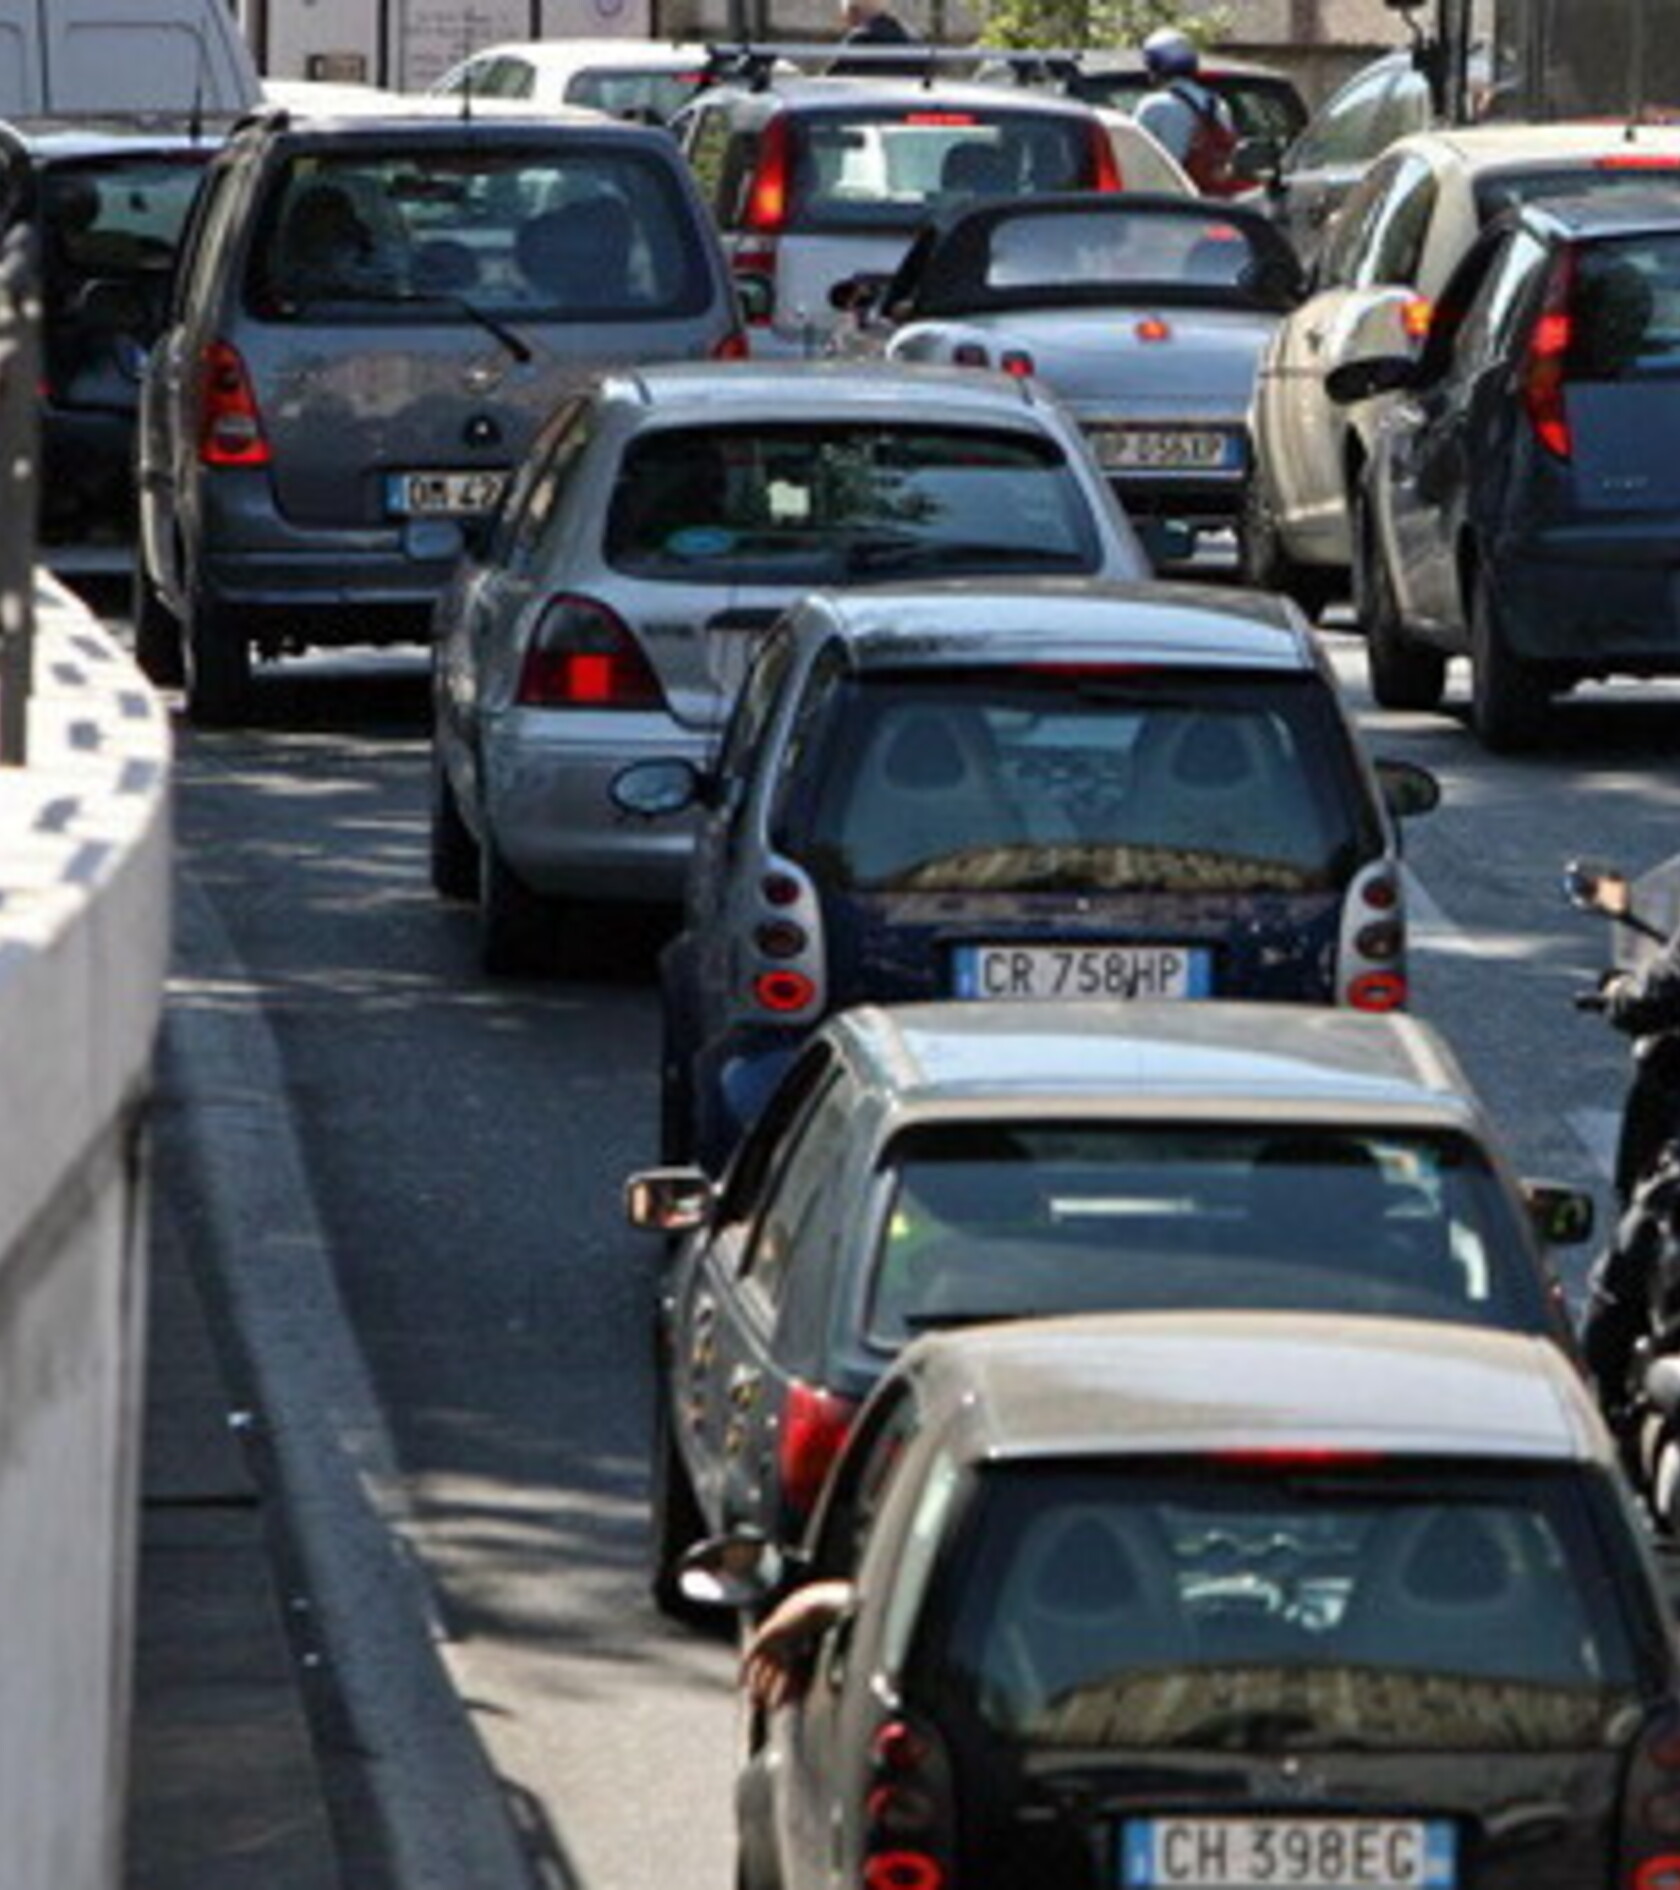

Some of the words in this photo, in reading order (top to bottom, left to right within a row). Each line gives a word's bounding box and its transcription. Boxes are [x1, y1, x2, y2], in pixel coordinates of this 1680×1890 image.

[983, 951, 1035, 994] CR
[1052, 951, 1183, 995] 758HP
[1162, 1826, 1228, 1882] CH
[1249, 1826, 1415, 1882] 398EG
